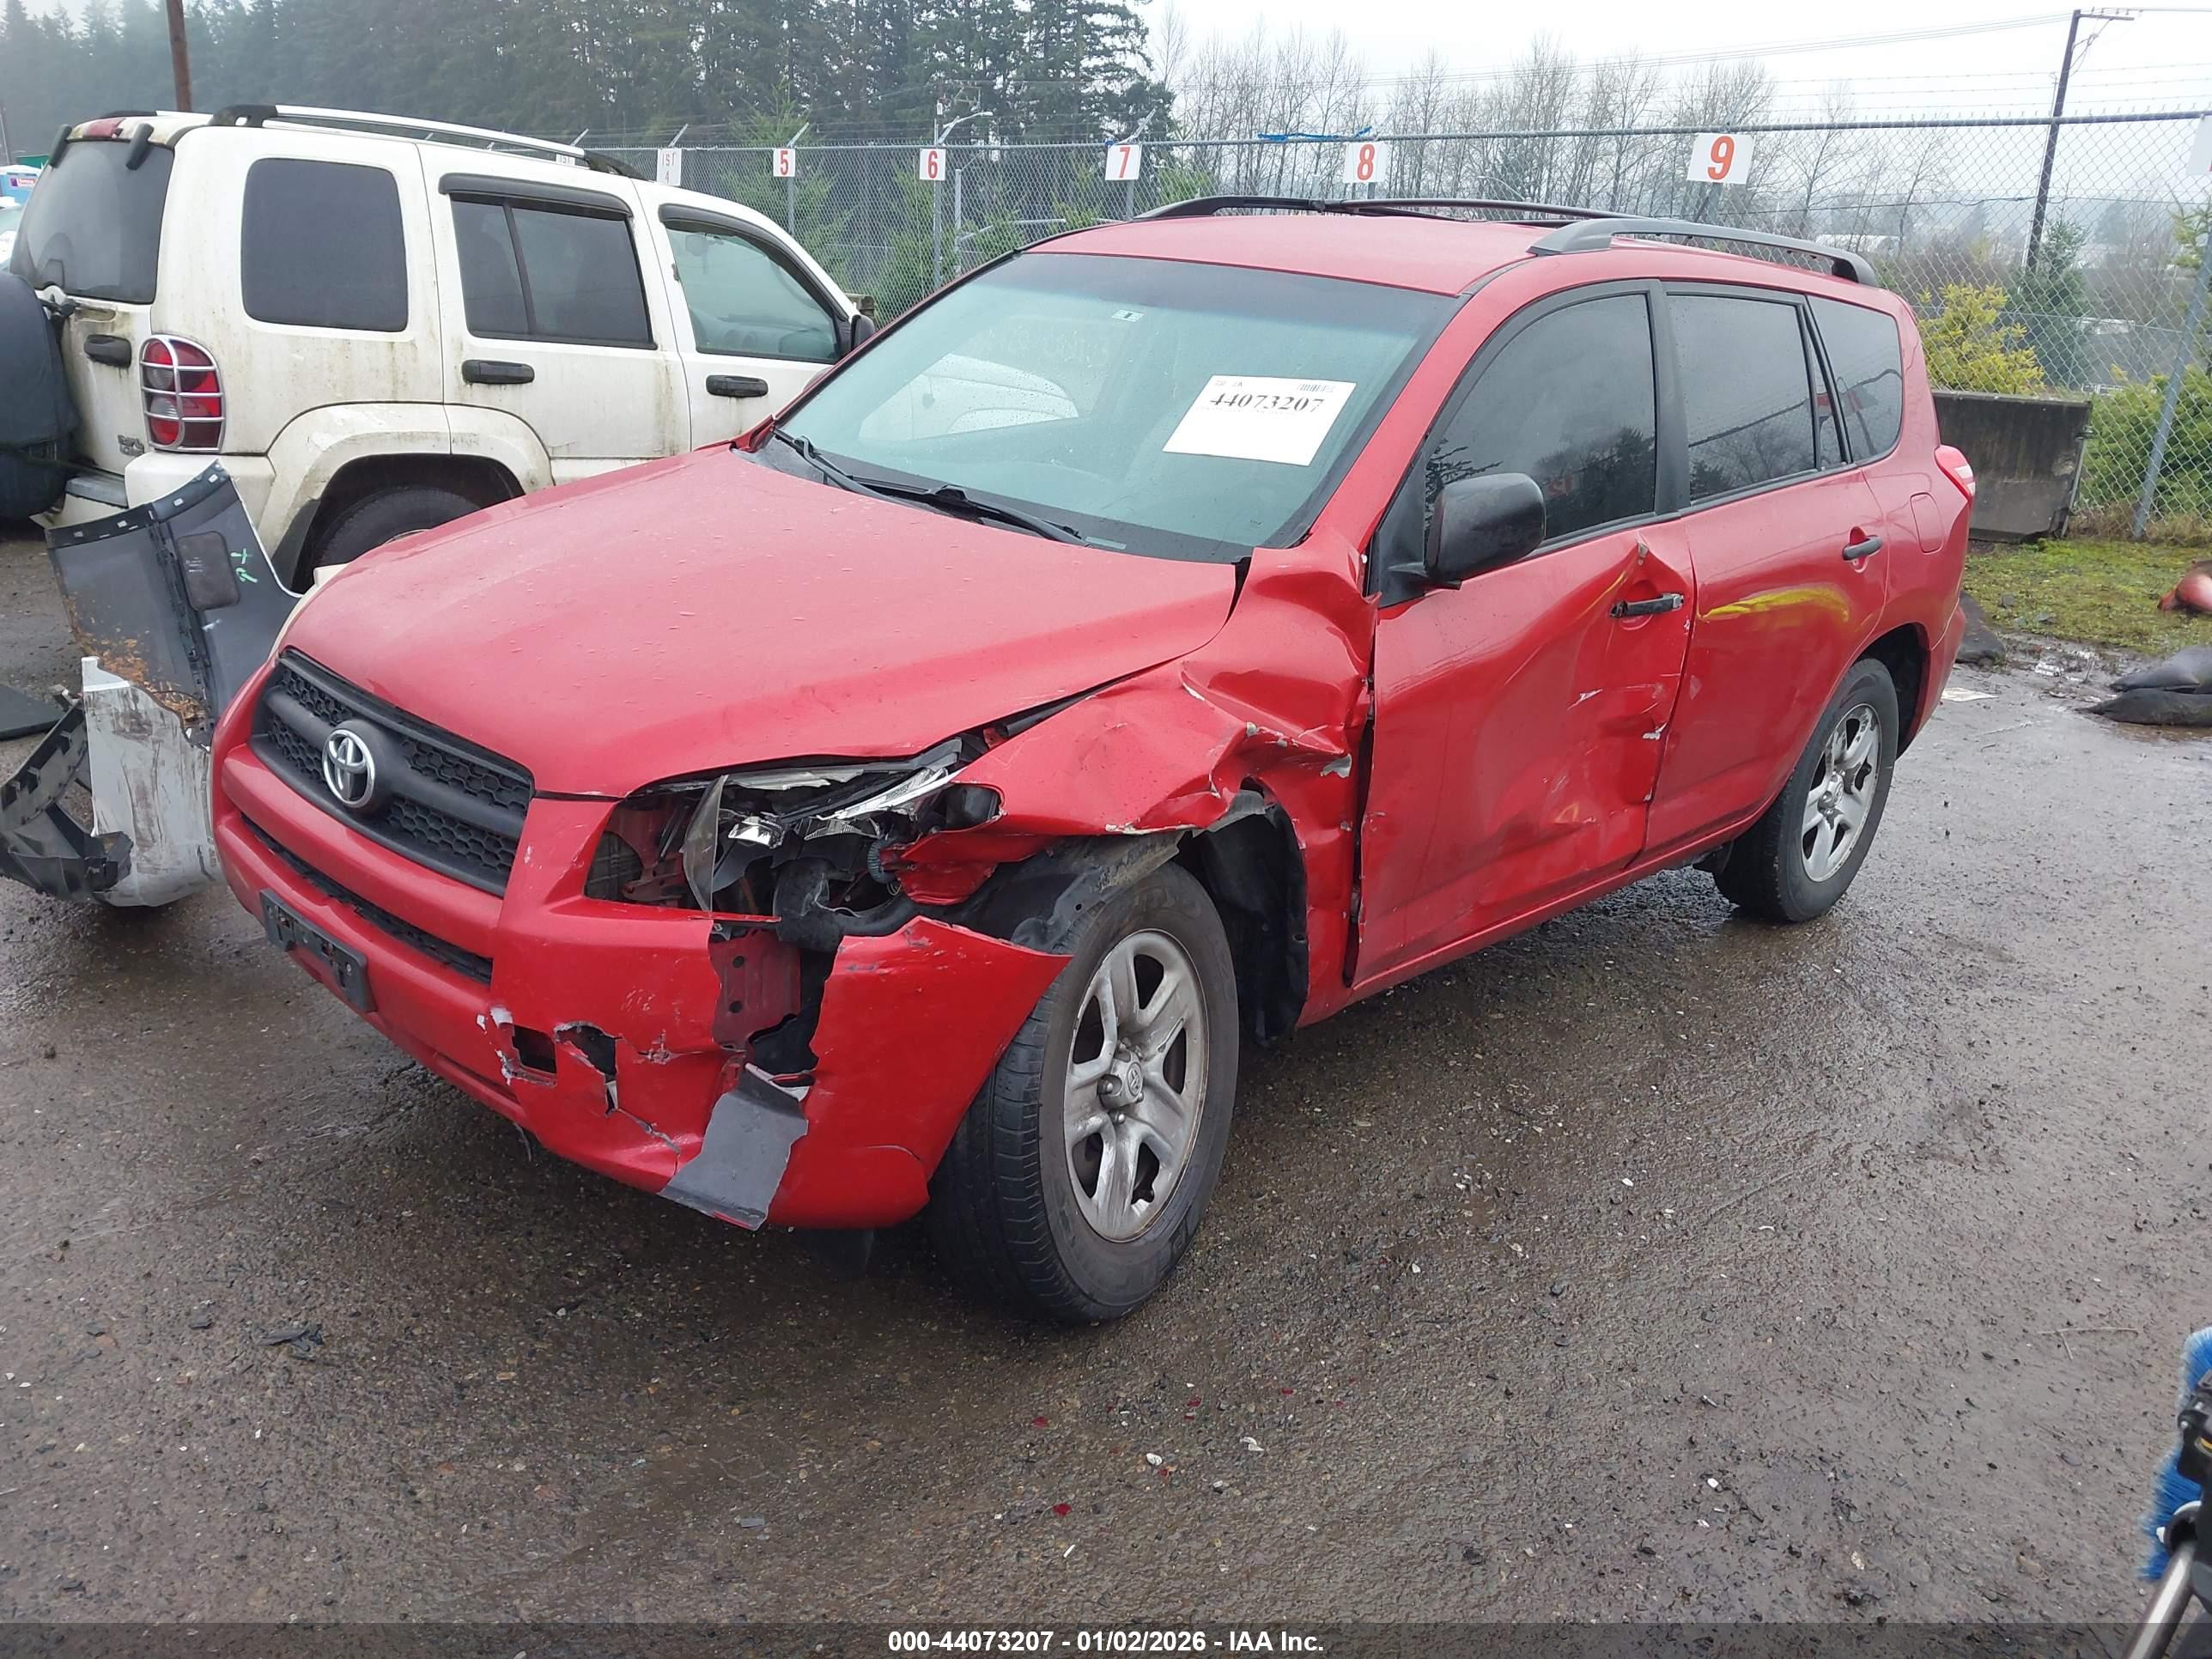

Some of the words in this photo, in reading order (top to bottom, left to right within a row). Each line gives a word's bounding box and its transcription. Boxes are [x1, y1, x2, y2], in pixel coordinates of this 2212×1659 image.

[780, 150, 789, 176] 5
[927, 150, 939, 179] 6
[1119, 146, 1131, 179] 7
[1357, 143, 1375, 180] 8
[1707, 135, 1735, 180] 9
[1209, 392, 1325, 412] 44073207
